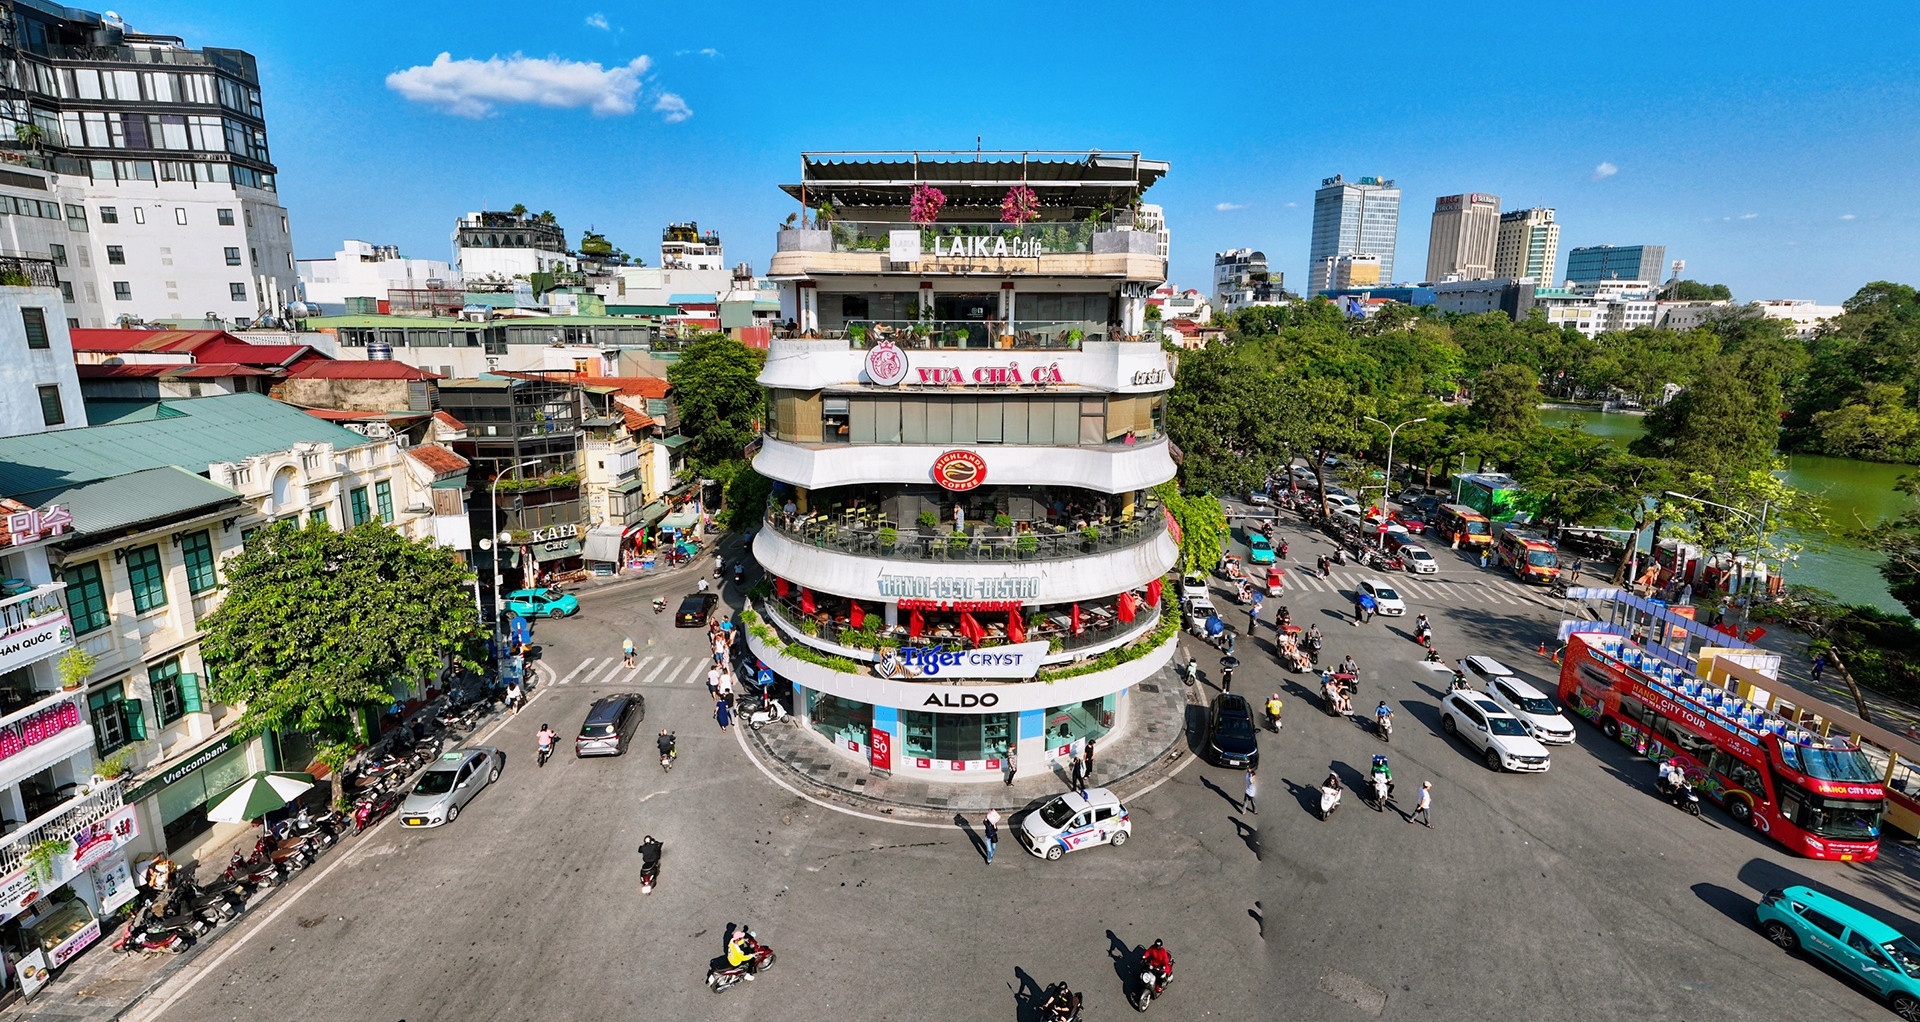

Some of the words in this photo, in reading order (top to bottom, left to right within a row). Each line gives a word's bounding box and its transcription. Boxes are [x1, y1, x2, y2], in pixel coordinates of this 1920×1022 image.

[935, 236, 1009, 257] LAIKA
[1012, 236, 1042, 258] Café
[1121, 283, 1148, 298] LAIKA
[915, 366, 966, 384] VUA
[972, 361, 1024, 384] CHẢ
[1031, 362, 1065, 384] CÁ
[936, 453, 984, 470] HIGHLANDS
[942, 479, 979, 489] COFFEE
[7, 504, 74, 546] 민수
[532, 523, 578, 542] KAFA
[544, 540, 569, 551] Café
[898, 599, 938, 611] COFFEE
[941, 601, 950, 612] &
[953, 600, 1024, 612] RESTAURANT
[901, 645, 966, 676] Tiger
[970, 653, 1024, 666] CRYST
[923, 692, 999, 708] ALDO
[1632, 683, 1659, 703] HANOI
[1661, 699, 1680, 714] CITY
[1682, 710, 1706, 730] TOUR
[873, 739, 887, 753] 50
[163, 742, 228, 785] Vietcombank
[1819, 785, 1847, 794] HANOI
[1865, 788, 1883, 796] TOUR
